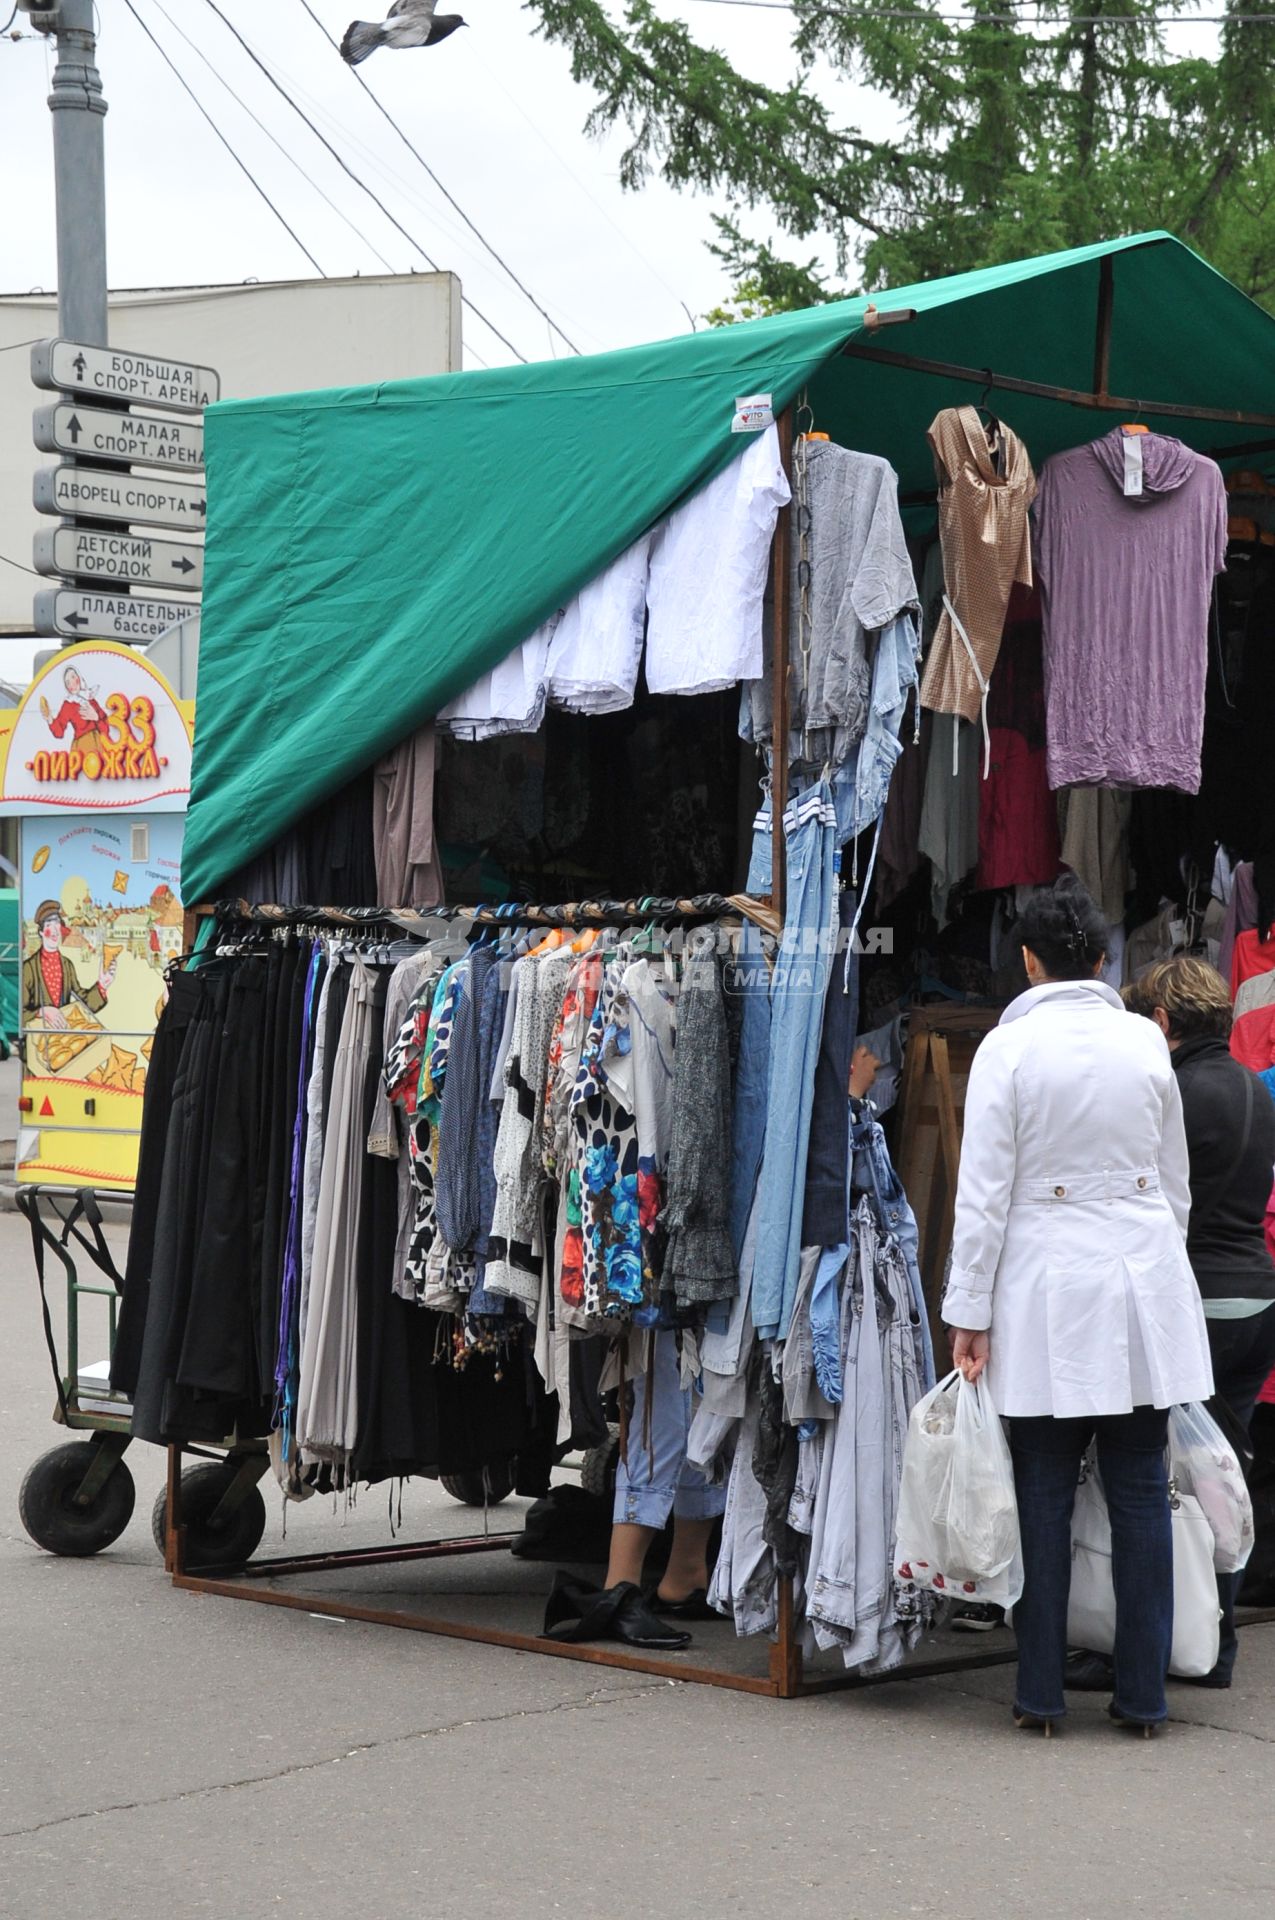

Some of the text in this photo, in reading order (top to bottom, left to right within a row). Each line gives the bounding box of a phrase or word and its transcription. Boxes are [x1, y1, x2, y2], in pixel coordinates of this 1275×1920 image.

[112, 356, 193, 385] БОЛЬШАЯ
[94, 372, 209, 406] СПОРТ. АРЕНА
[121, 420, 180, 442] МАЛАЯ
[94, 434, 153, 456] СПОРТ.
[58, 482, 187, 513] ДВОРЕЦ СПОРТА
[77, 535, 152, 559] ДЕТСКИЙ
[76, 555, 151, 578] ГОРОДОК
[113, 616, 169, 635] бассей
[102, 693, 155, 750] 33
[33, 750, 160, 781] ПИРОЖКА
